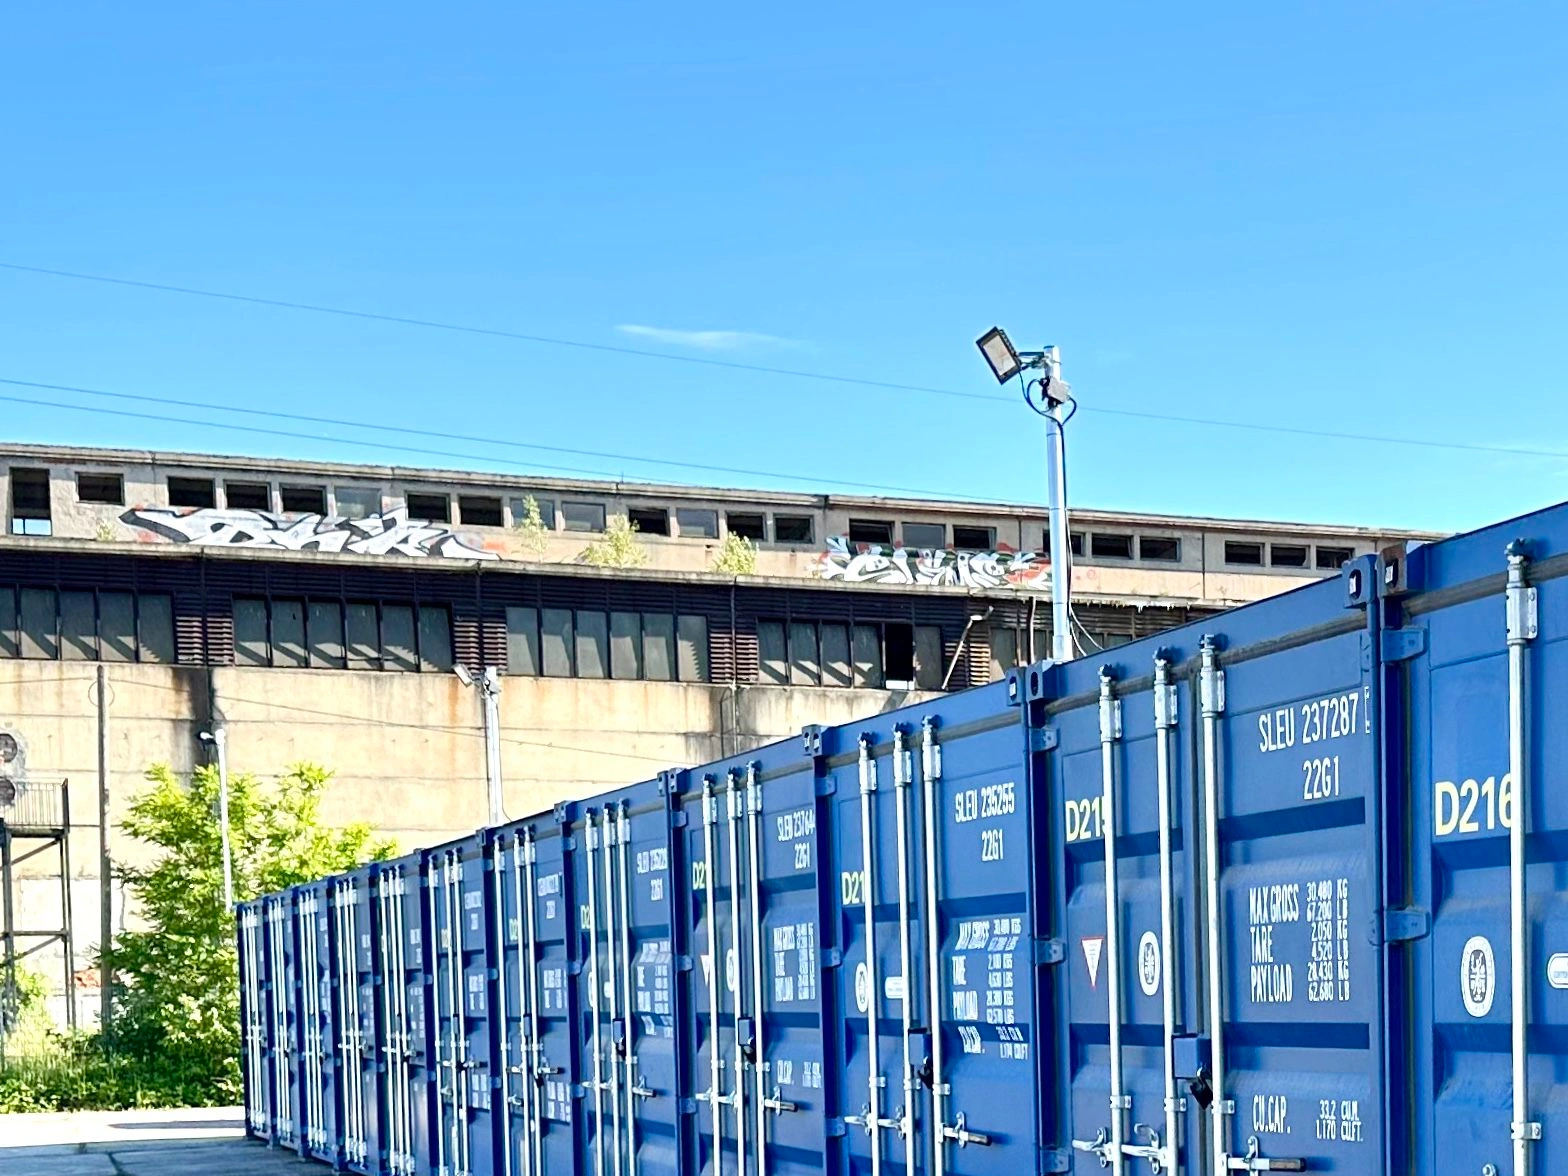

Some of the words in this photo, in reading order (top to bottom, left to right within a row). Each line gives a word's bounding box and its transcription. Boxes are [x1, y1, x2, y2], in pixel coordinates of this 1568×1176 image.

[1259, 707, 1295, 753] SLEU
[1302, 692, 1359, 744] 237287
[1303, 755, 1339, 800] 22G1
[955, 789, 978, 823] SLEU
[1066, 796, 1104, 842] D21
[1435, 773, 1511, 836] D216
[982, 828, 1003, 861] 22G1
[1249, 886, 1268, 925] MAX
[1270, 883, 1299, 923] GROSS
[1250, 925, 1273, 963] TARE
[1250, 963, 1293, 1003] PAYLOAD
